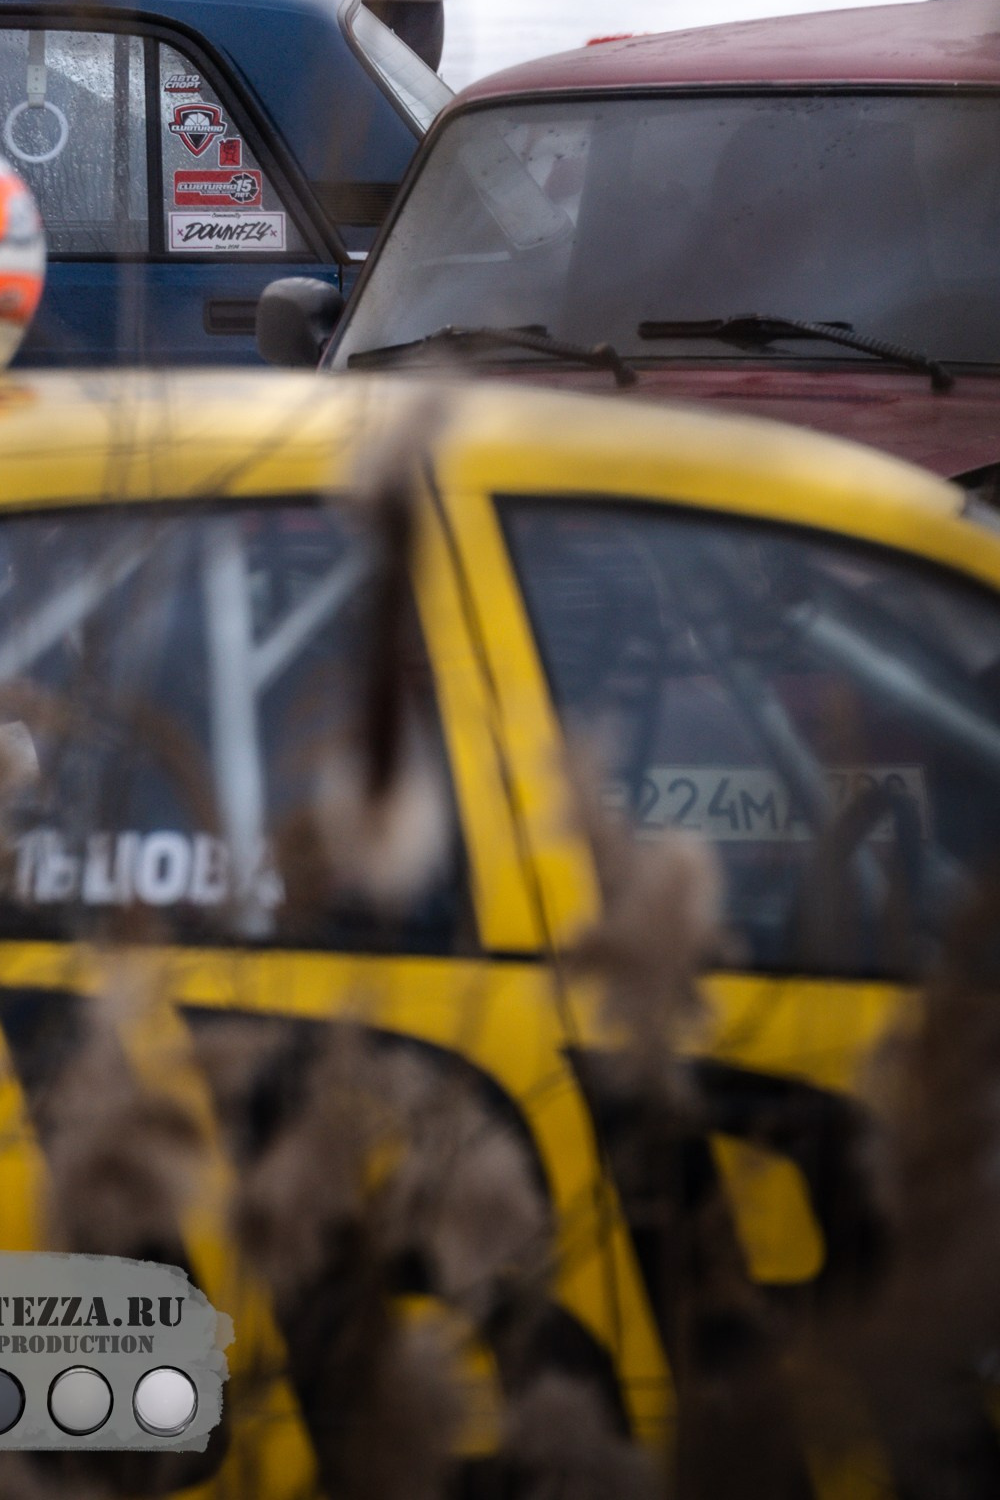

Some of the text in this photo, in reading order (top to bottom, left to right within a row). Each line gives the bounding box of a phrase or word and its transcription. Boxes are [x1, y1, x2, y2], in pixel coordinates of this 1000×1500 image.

[169, 74, 200, 82] АВТО
[165, 81, 201, 89] СПОРТ
[236, 179, 253, 193] 15
